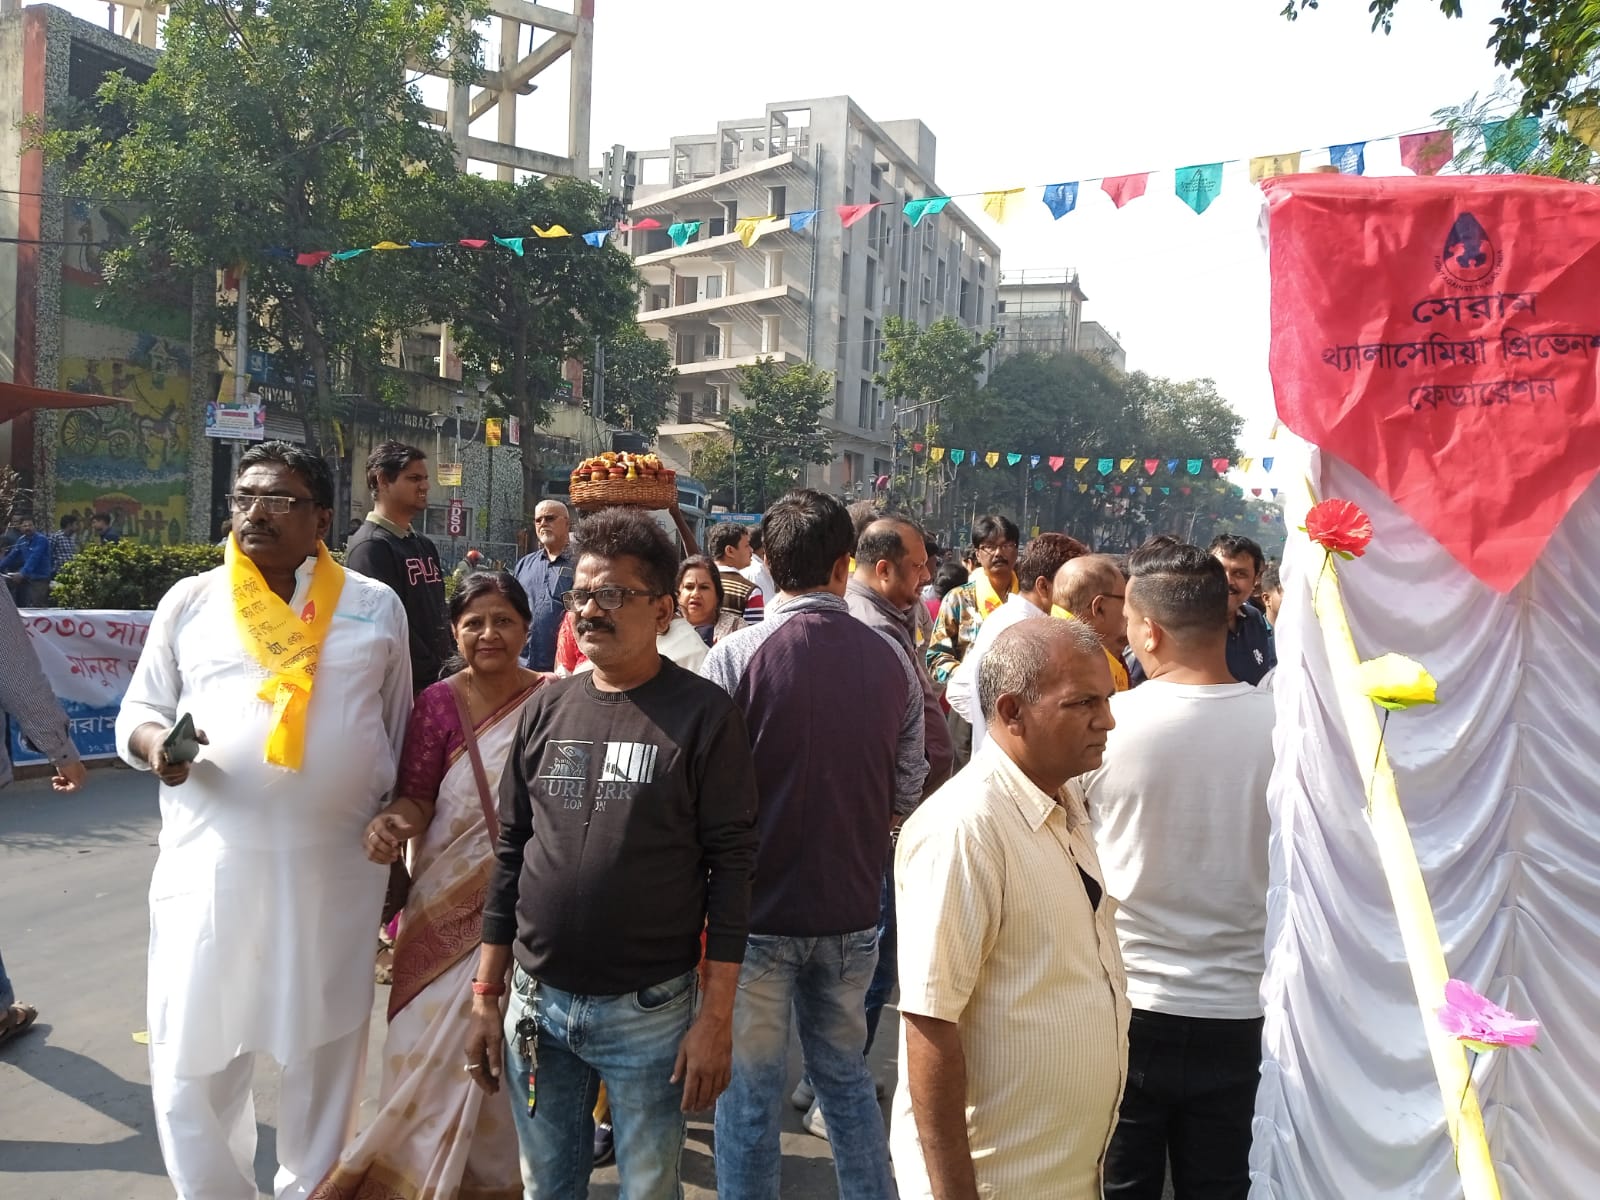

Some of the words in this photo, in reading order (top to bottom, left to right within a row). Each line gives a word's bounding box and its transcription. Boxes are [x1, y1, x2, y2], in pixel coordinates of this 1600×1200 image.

[1412, 291, 1537, 323] সেরাম
[379, 411, 442, 431] SHYAMBAZ
[66, 655, 121, 688] মানুষ
